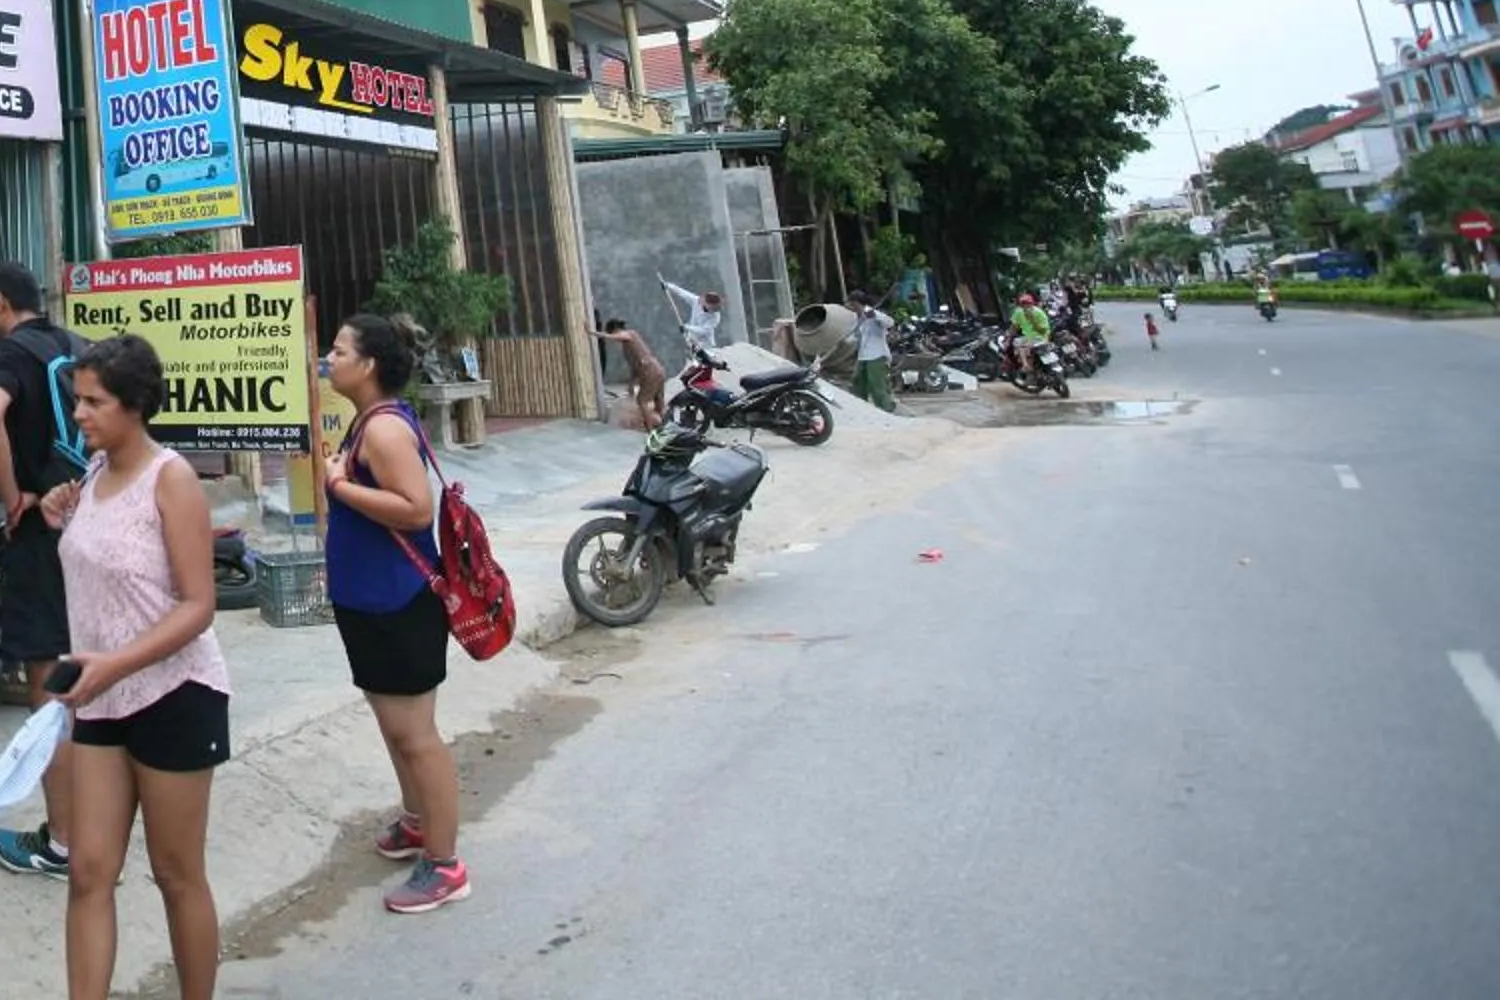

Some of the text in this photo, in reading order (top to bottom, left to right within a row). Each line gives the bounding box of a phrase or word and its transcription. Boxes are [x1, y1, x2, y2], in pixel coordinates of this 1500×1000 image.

[240, 23, 435, 117] Sky HOTEL
[110, 80, 219, 128] BOOKING
[125, 123, 211, 168] OFFICE
[94, 258, 293, 287] Hai's Phong Nha Motorbikes
[73, 293, 295, 326] Rent, Sell and Buy
[179, 321, 293, 341] Motorbikes
[195, 359, 216, 373] and
[218, 357, 290, 374] professional
[160, 375, 287, 414] HANIC
